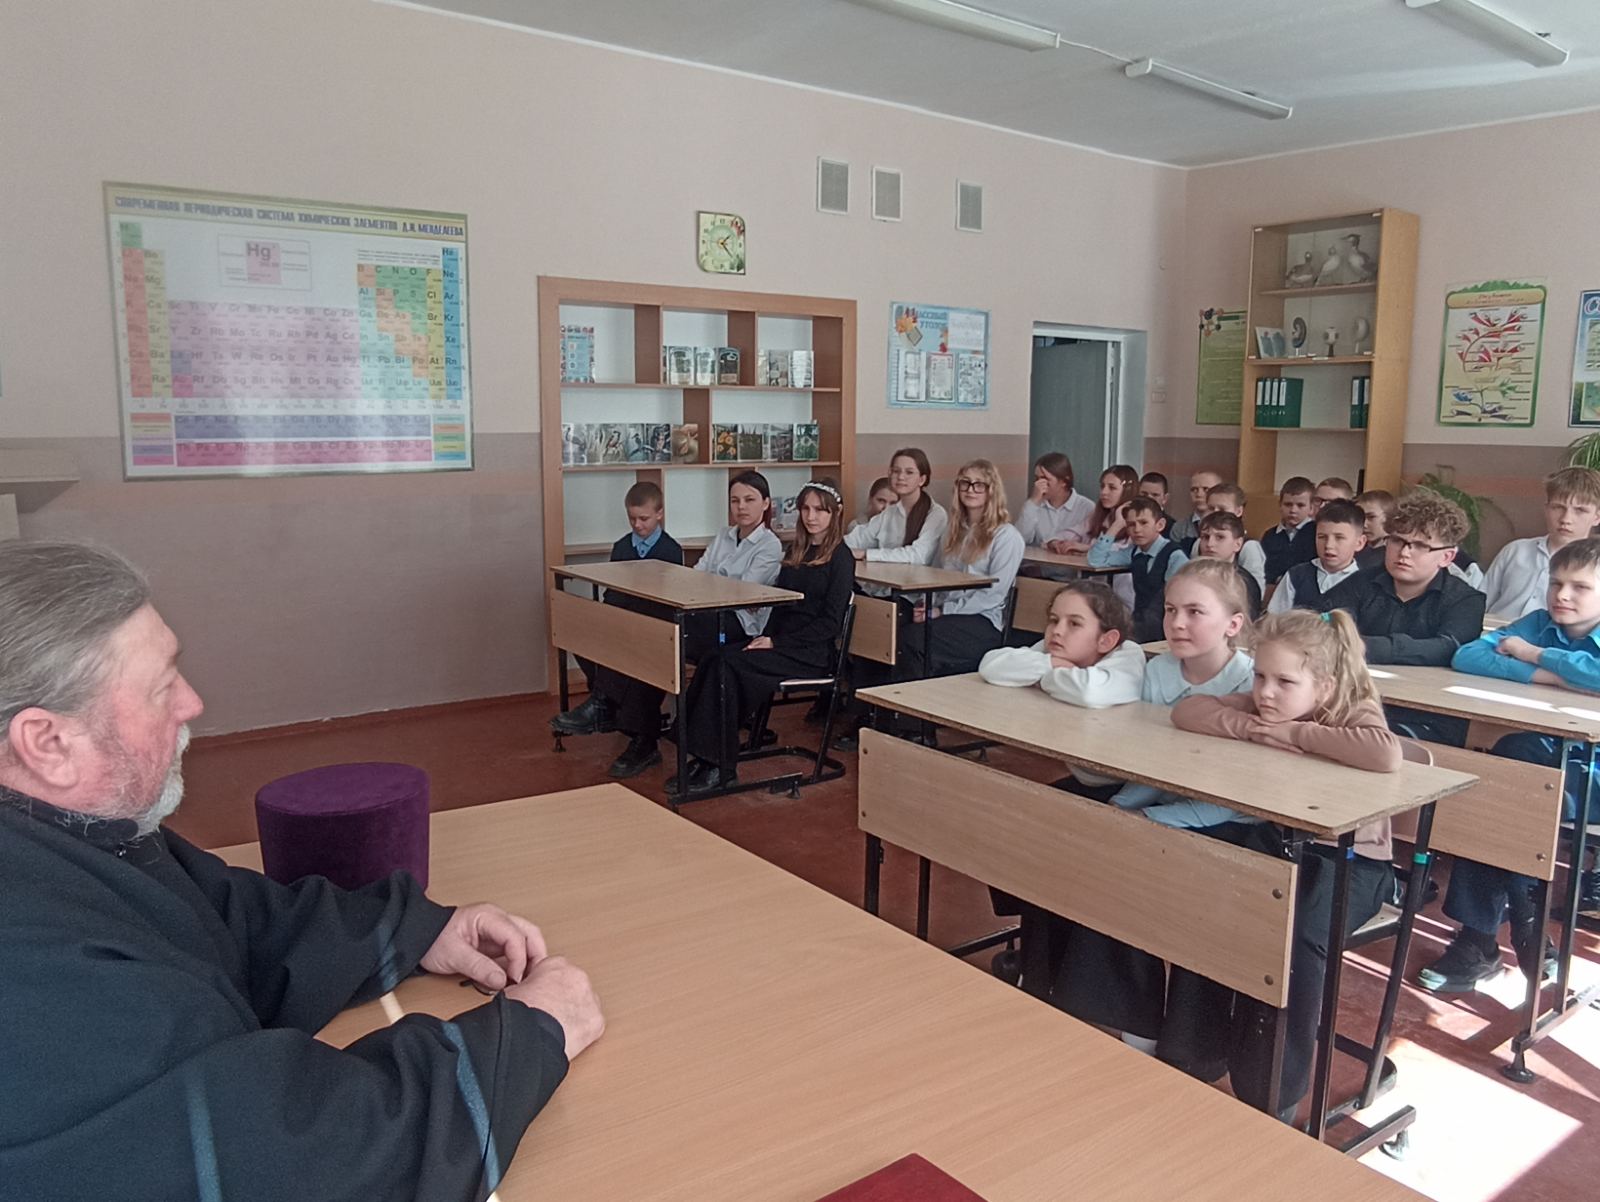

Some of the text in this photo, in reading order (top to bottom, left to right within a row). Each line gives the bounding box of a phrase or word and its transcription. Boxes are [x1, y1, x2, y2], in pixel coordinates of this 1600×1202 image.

[256, 209, 295, 222] СИСТЕМА
[298, 212, 350, 226] ХИМИЧЕСКИХ
[354, 217, 398, 231] ЭЛЕМЕНТОВ
[418, 223, 464, 236] МЕНДЕЛЕЕВА
[247, 242, 271, 260] Hg
[409, 267, 418, 276] O
[442, 270, 454, 278] Ne
[427, 291, 436, 299] Cl
[444, 292, 454, 300] Ar
[428, 312, 438, 320] Br
[444, 313, 454, 321] Kr
